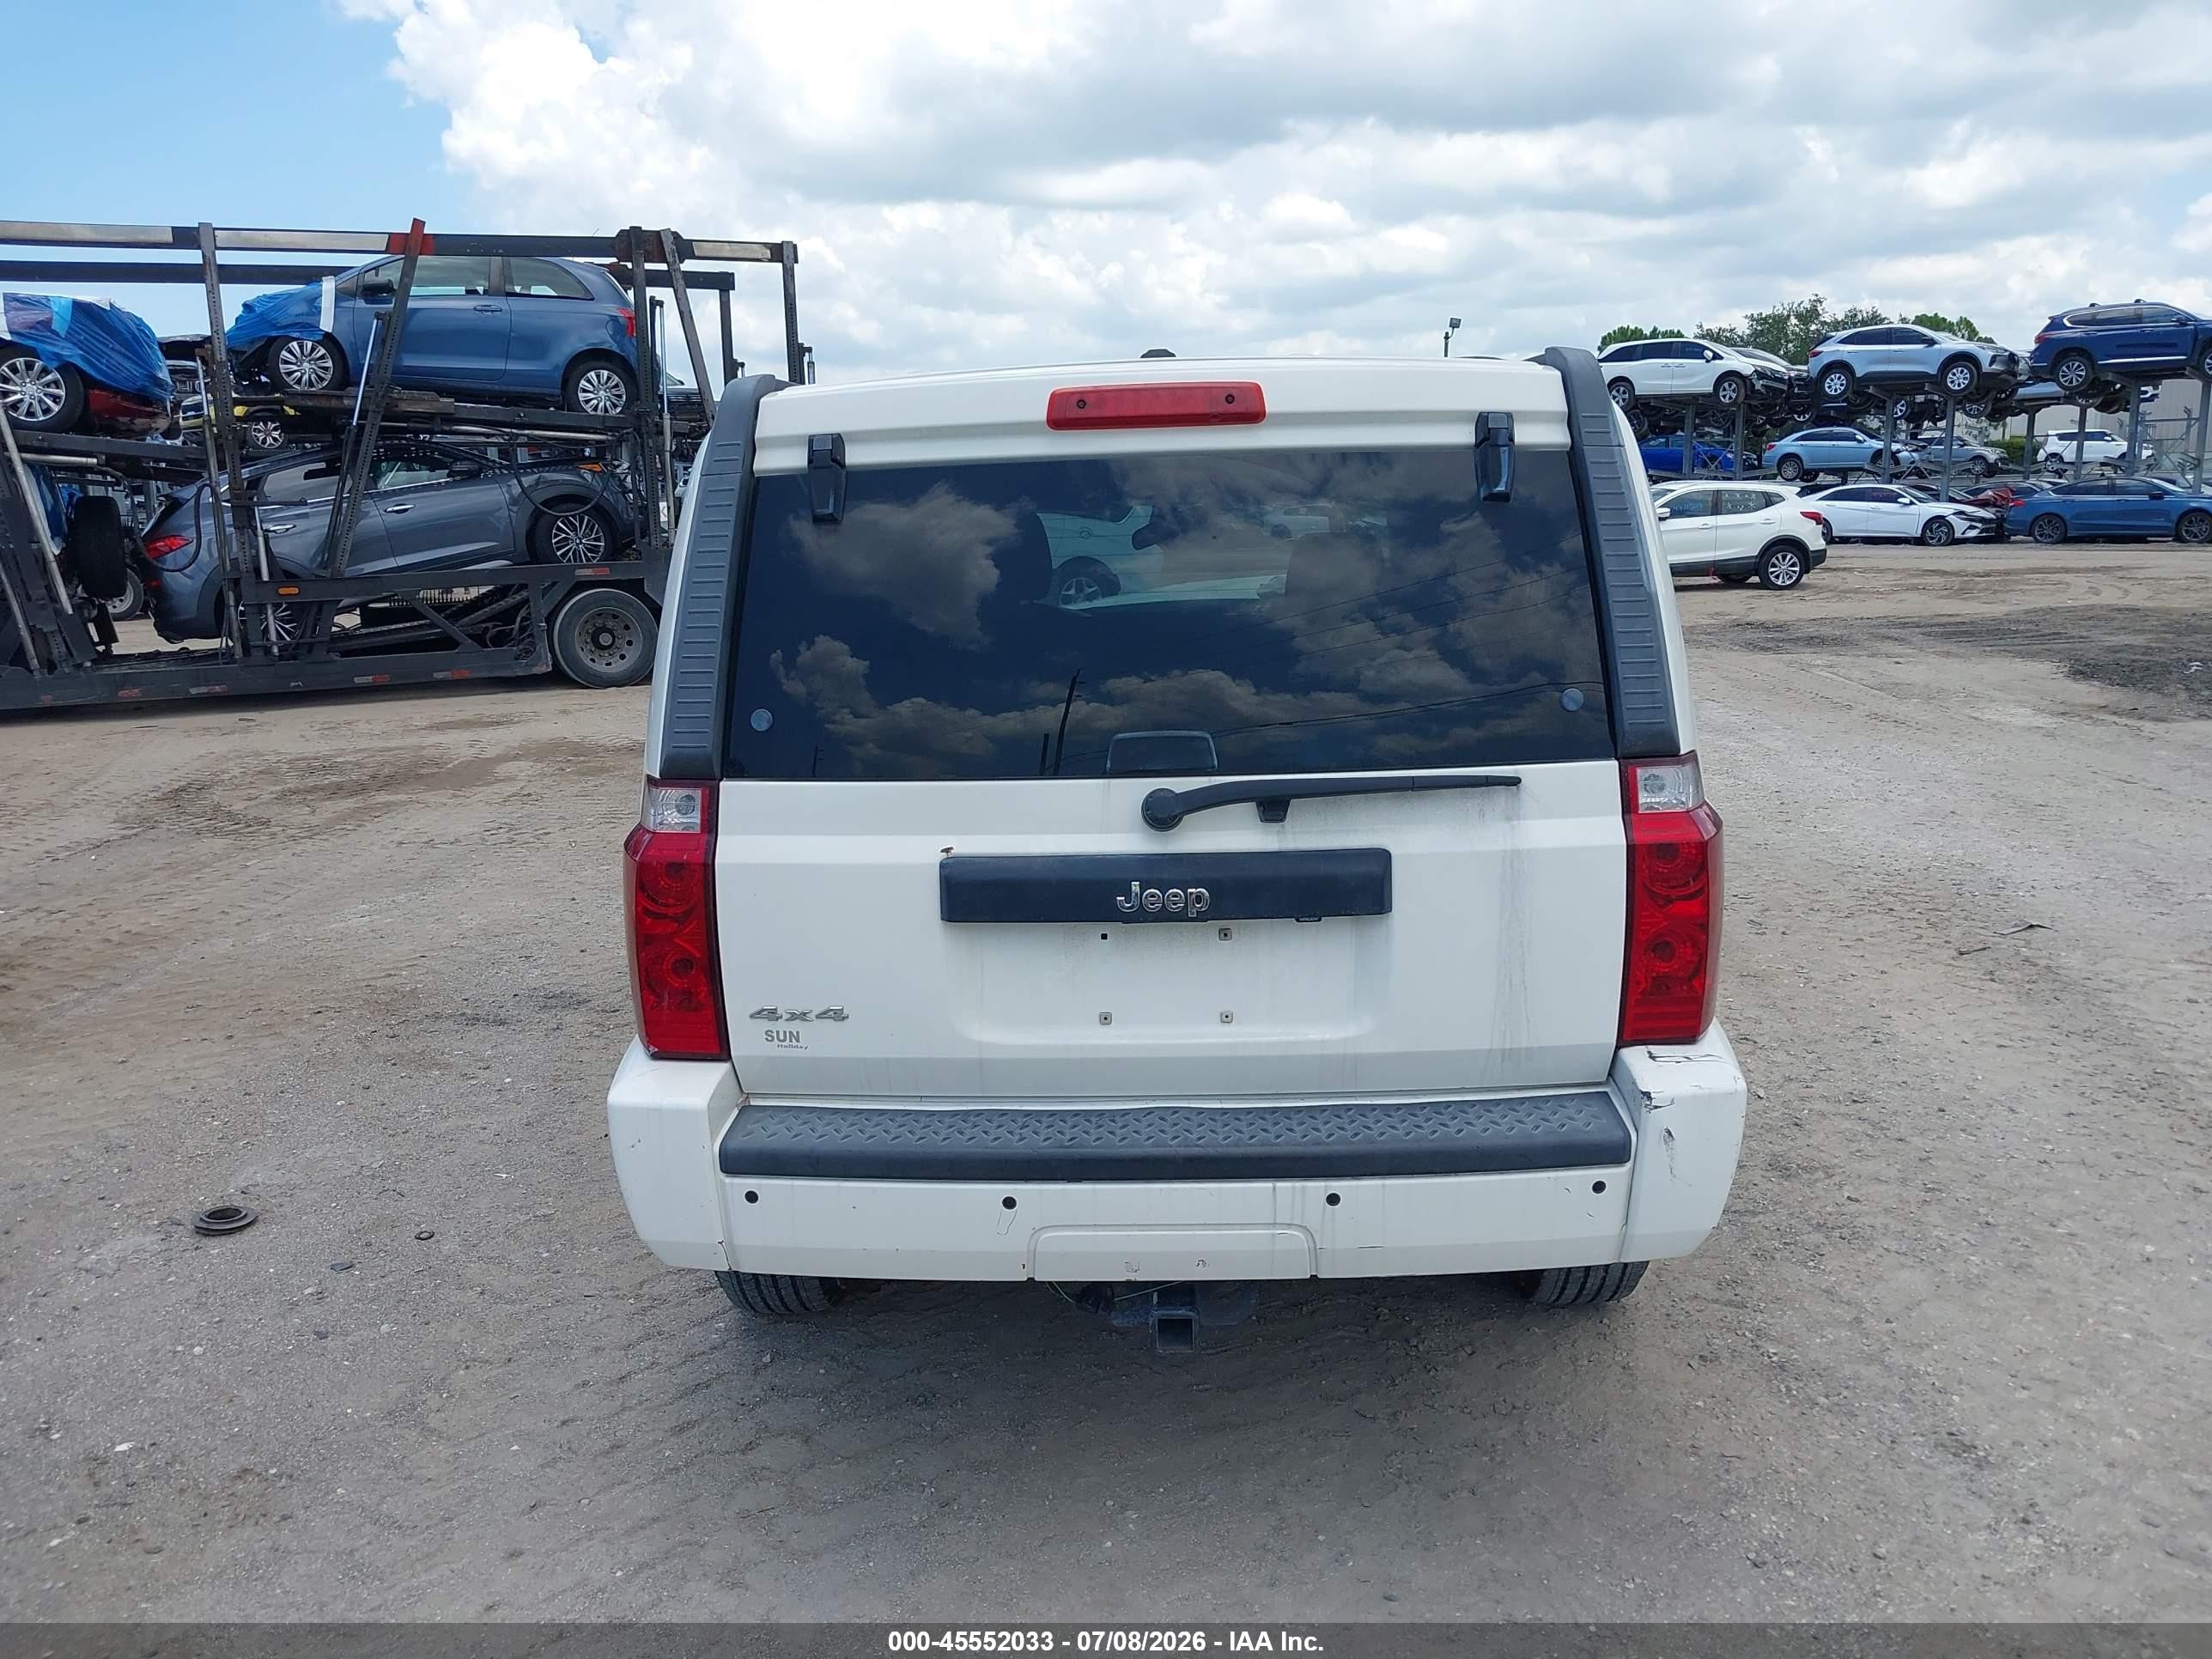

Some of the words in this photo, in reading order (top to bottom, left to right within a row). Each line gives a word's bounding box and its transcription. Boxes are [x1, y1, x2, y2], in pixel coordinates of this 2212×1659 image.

[1116, 881, 1210, 917] Jeep
[749, 1006, 849, 1022] 4x4
[764, 1030, 800, 1043] SUN
